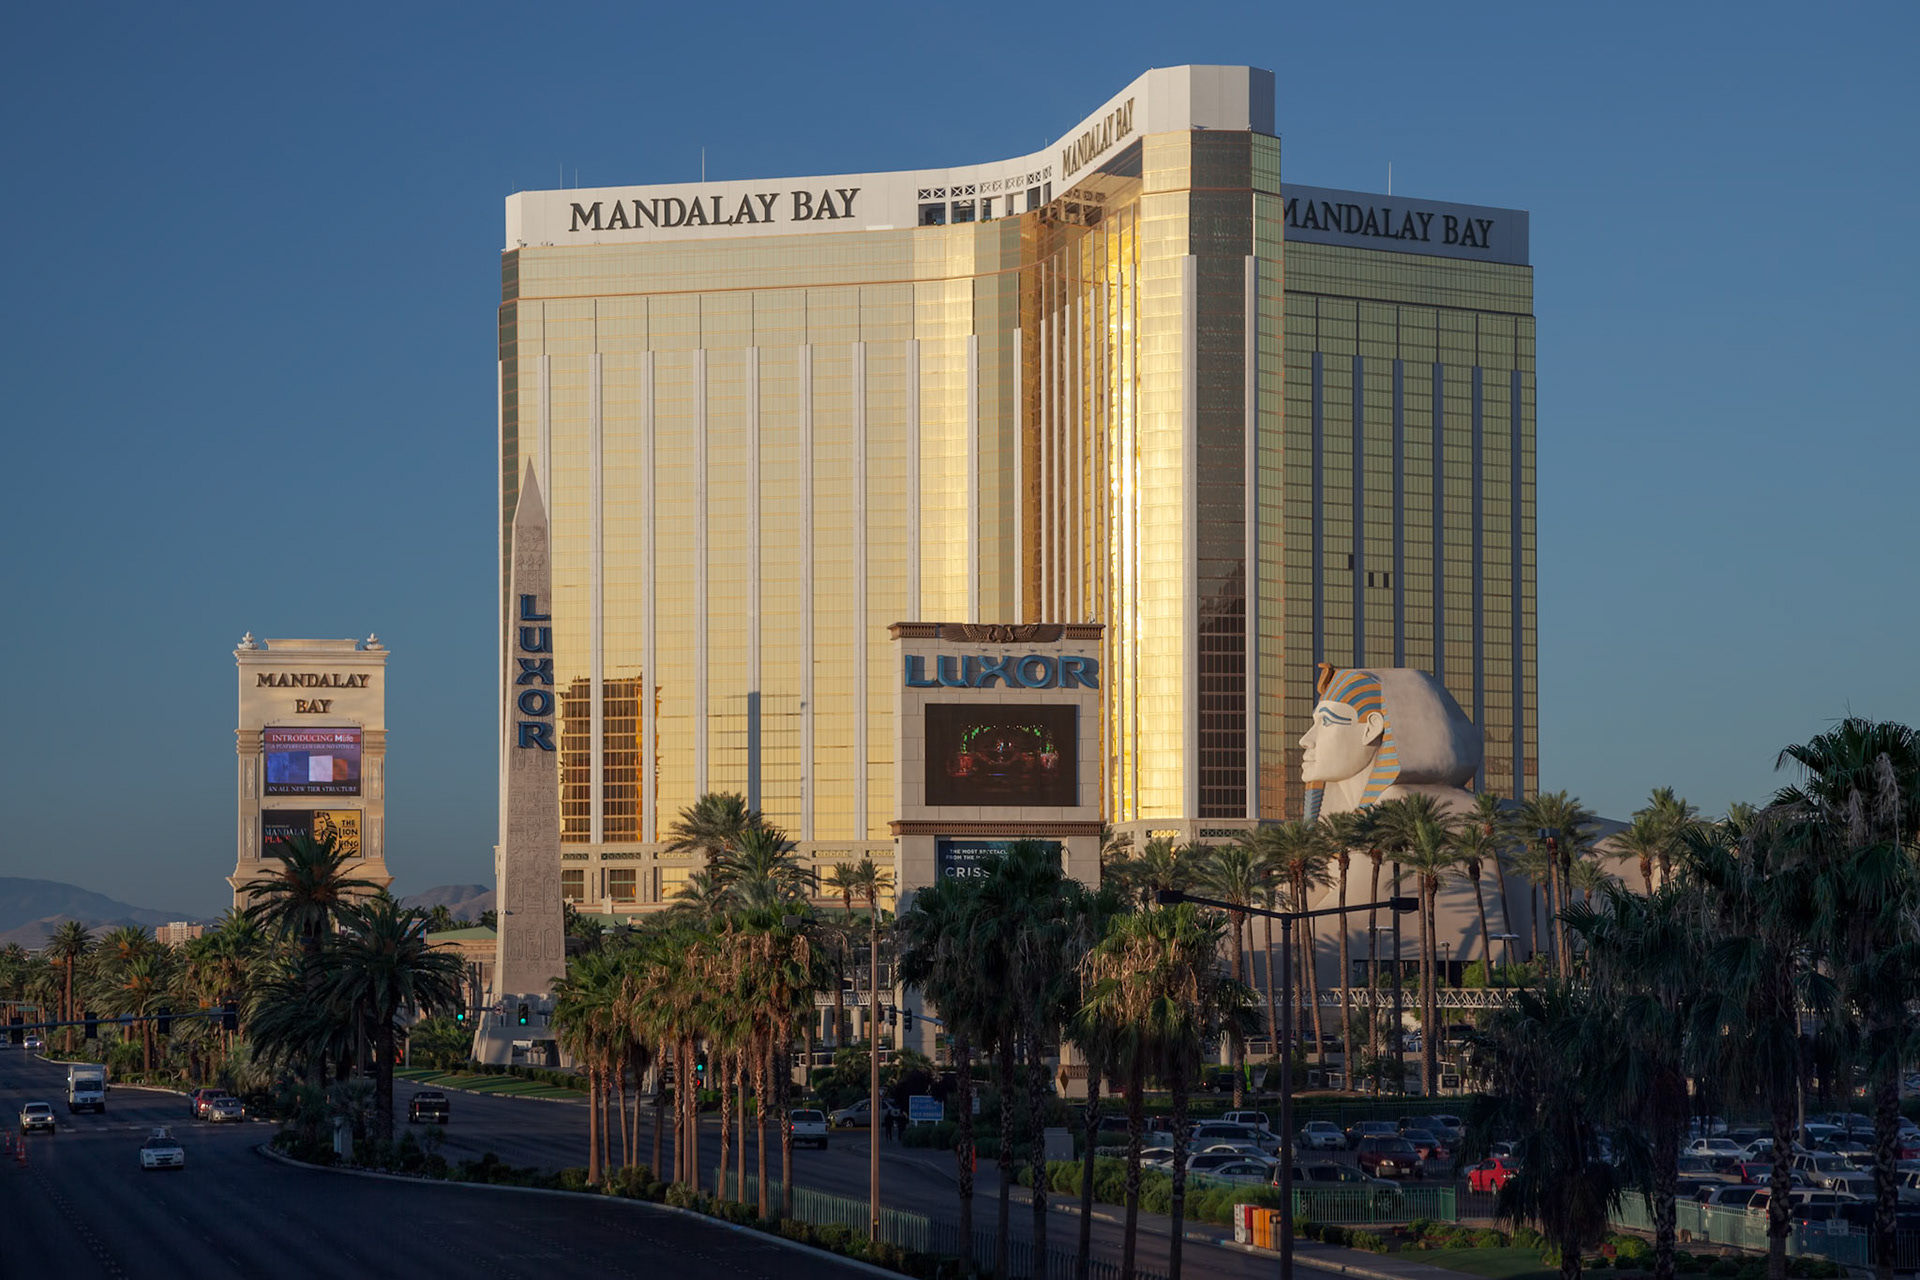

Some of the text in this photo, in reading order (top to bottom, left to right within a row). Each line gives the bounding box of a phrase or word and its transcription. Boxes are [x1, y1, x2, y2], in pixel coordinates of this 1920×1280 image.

[1062, 97, 1135, 181] MANDALAY BAY
[569, 188, 861, 232] MANDALAY BAY
[1442, 214, 1494, 249] BAY
[256, 673, 370, 688] MANDALAY
[516, 594, 556, 751] LUXOR
[905, 654, 1098, 689] LUXOR
[295, 699, 331, 714] BAY
[272, 734, 333, 742] INTRODUCING
[338, 828, 358, 838] LION
